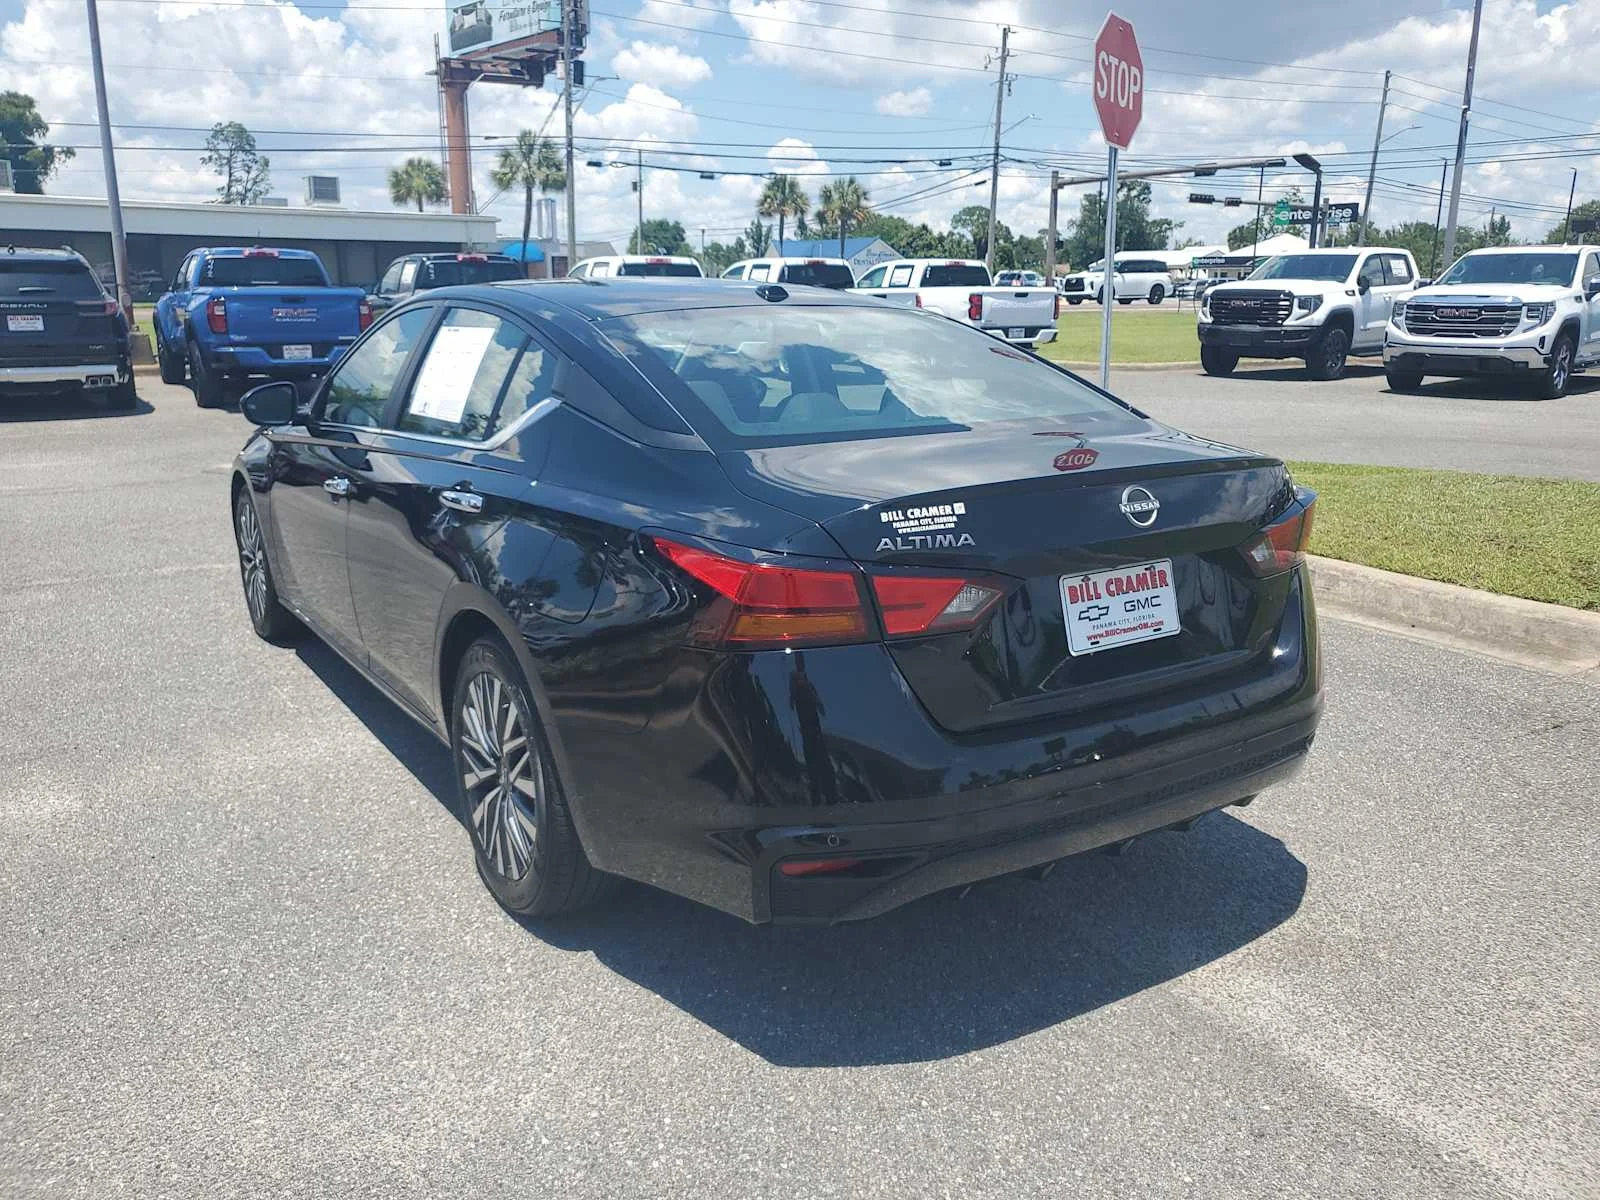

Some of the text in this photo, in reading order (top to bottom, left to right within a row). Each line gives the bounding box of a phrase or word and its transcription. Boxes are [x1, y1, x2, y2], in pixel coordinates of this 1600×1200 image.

[1097, 50, 1141, 111] STOP
[1231, 300, 1261, 308] GMC
[1436, 308, 1480, 317] GMC
[880, 510, 905, 522] BILL
[906, 504, 954, 519] CRAMER
[1121, 500, 1160, 513] NISSAN
[892, 519, 920, 529] PANAMA
[934, 515, 958, 525] FLORIDA
[876, 533, 977, 552] ALTIMA
[1067, 569, 1169, 605] BILL CRAMER
[1123, 595, 1162, 613] GMC
[1092, 621, 1117, 632] PANAMA
[1132, 613, 1156, 623] FLORIDA
